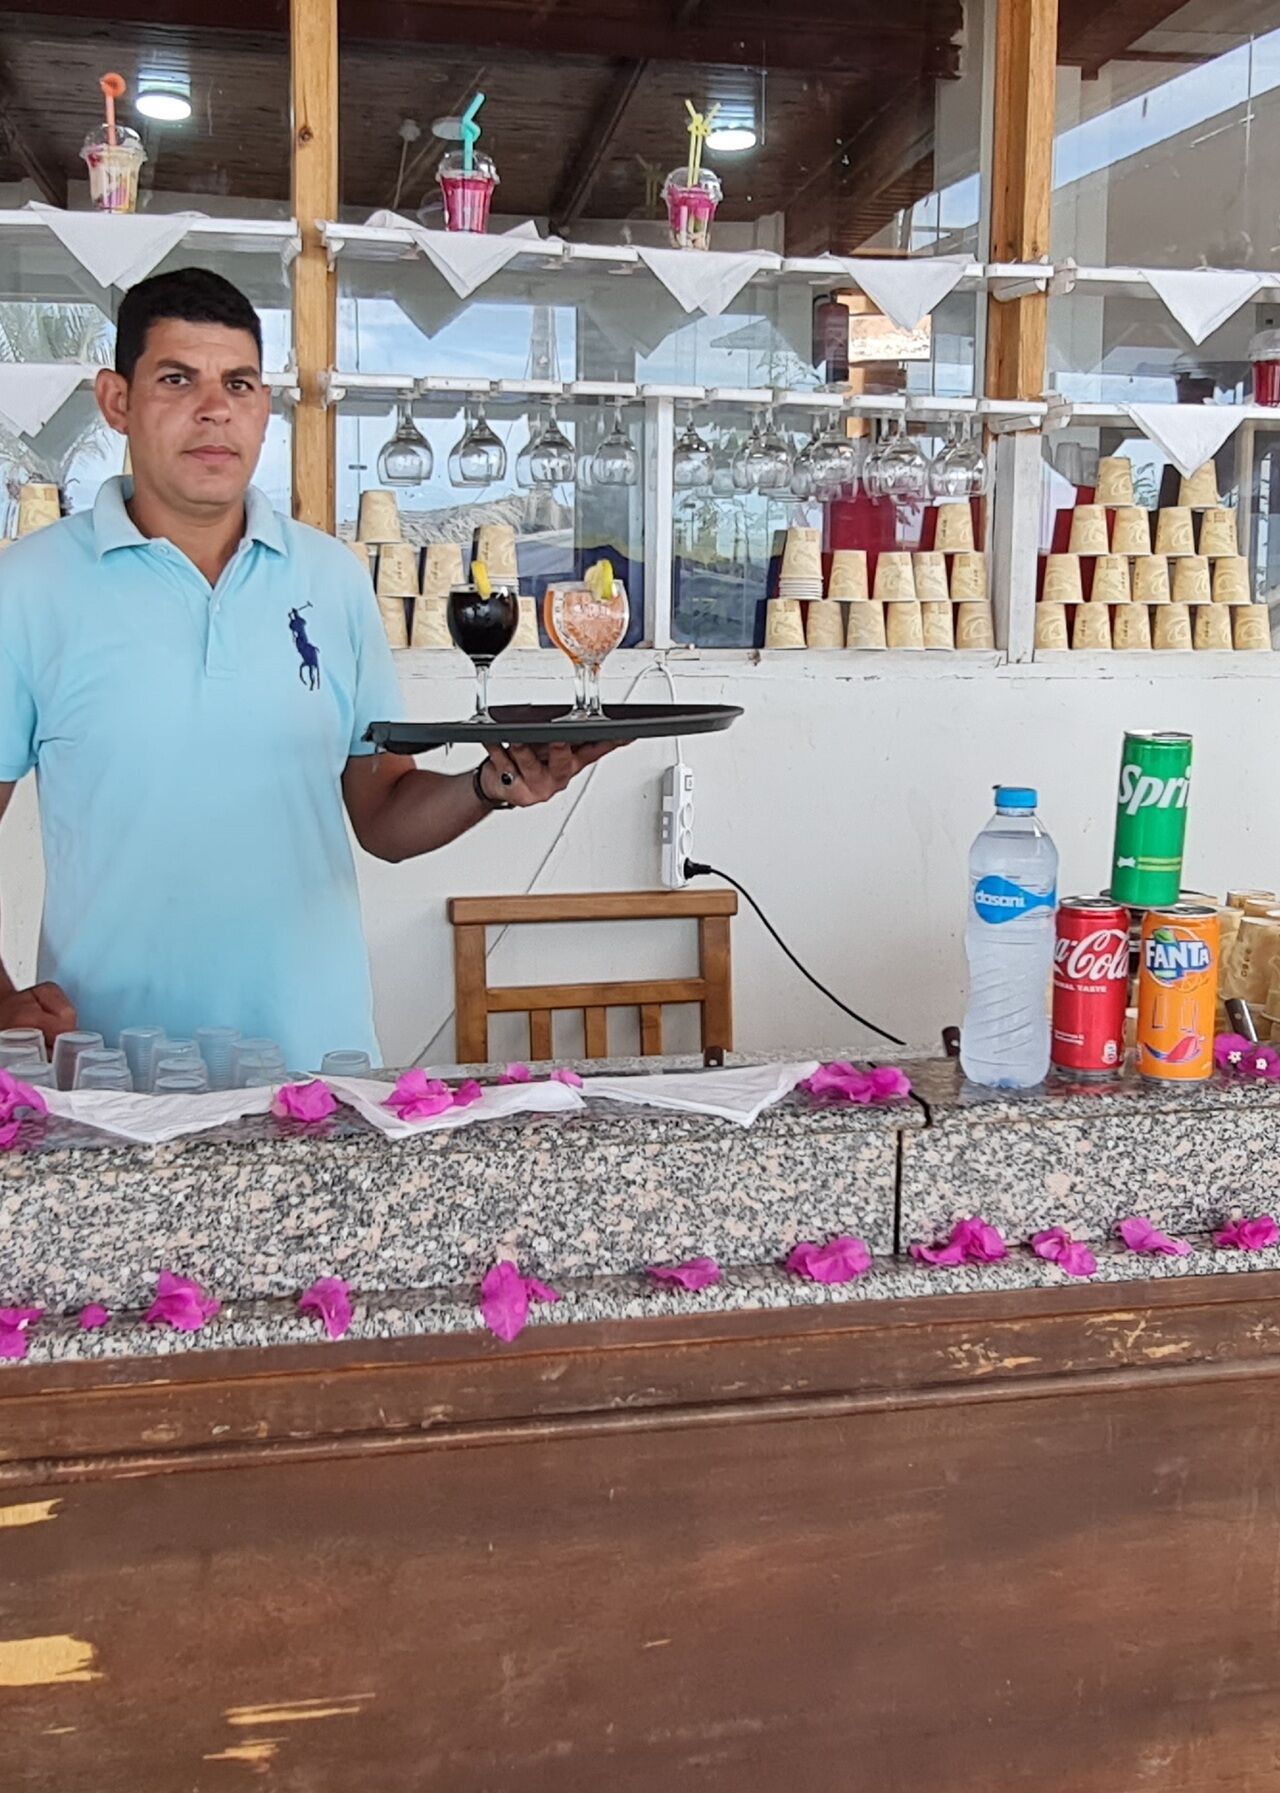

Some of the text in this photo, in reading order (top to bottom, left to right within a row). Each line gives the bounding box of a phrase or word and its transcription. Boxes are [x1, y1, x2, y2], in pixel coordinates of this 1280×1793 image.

[1118, 764, 1191, 816] Spri
[975, 889, 1026, 909] dasani
[1055, 929, 1129, 981] a-Cola
[1145, 939, 1210, 969] FANTA
[1076, 984, 1108, 993] TASTE
